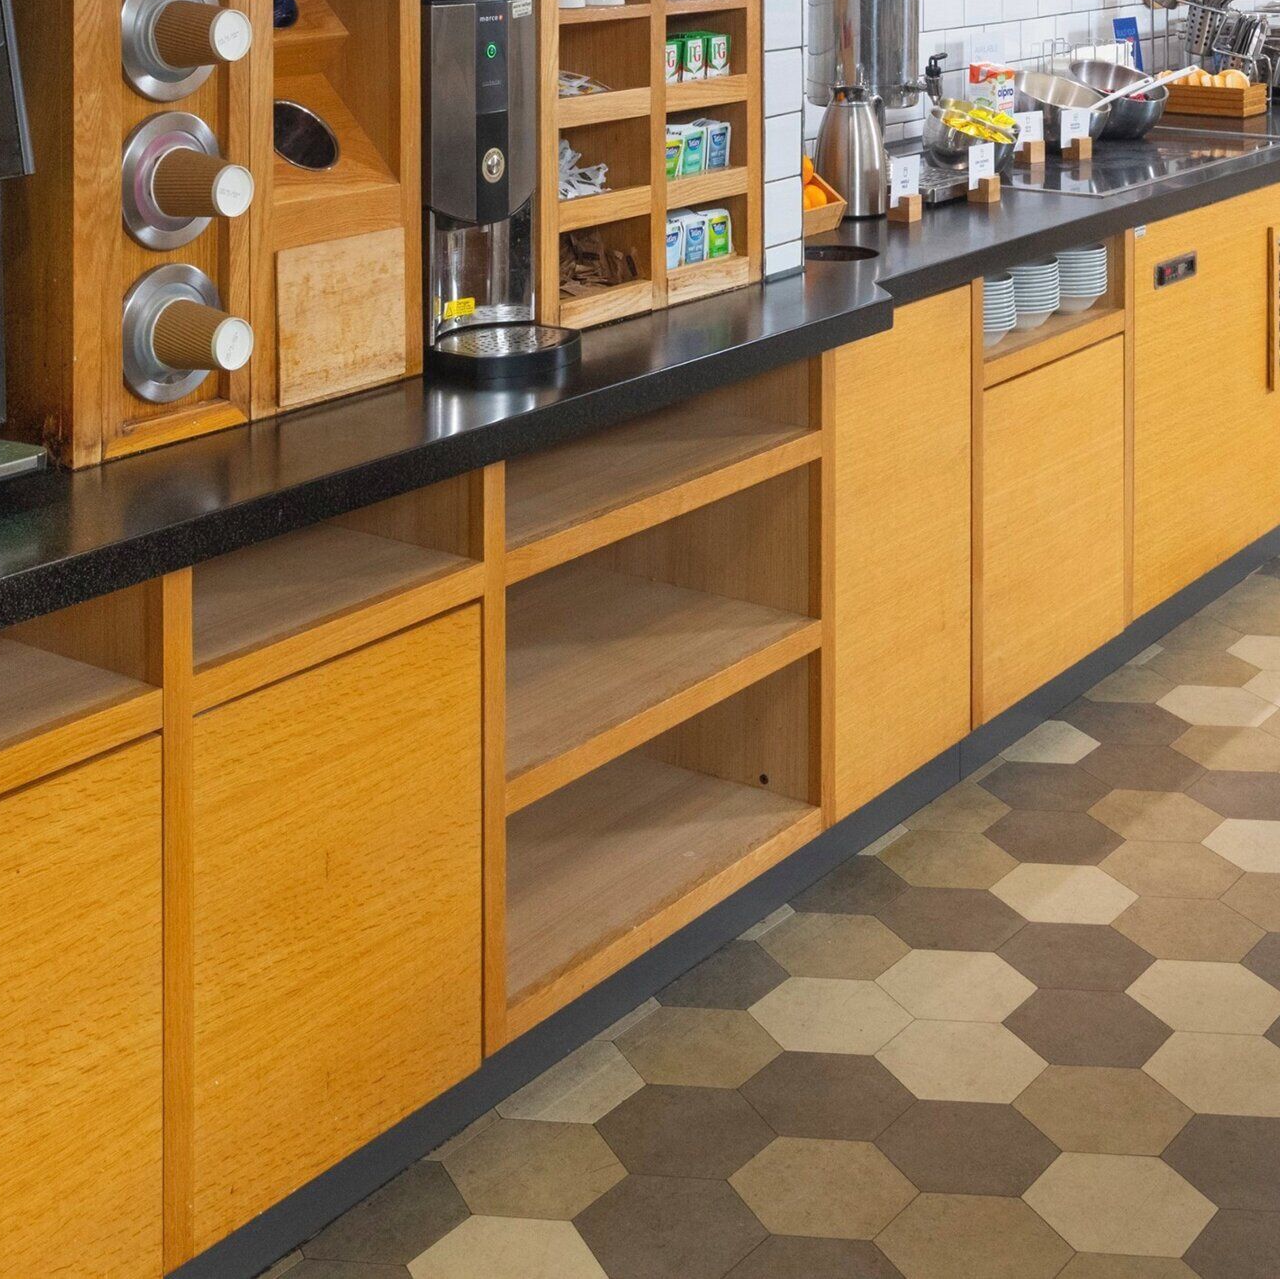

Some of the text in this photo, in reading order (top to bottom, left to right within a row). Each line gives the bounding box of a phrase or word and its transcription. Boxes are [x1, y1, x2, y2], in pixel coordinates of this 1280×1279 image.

[689, 45, 700, 62] PG
[713, 42, 725, 59] PG
[998, 87, 1014, 99] alpro
